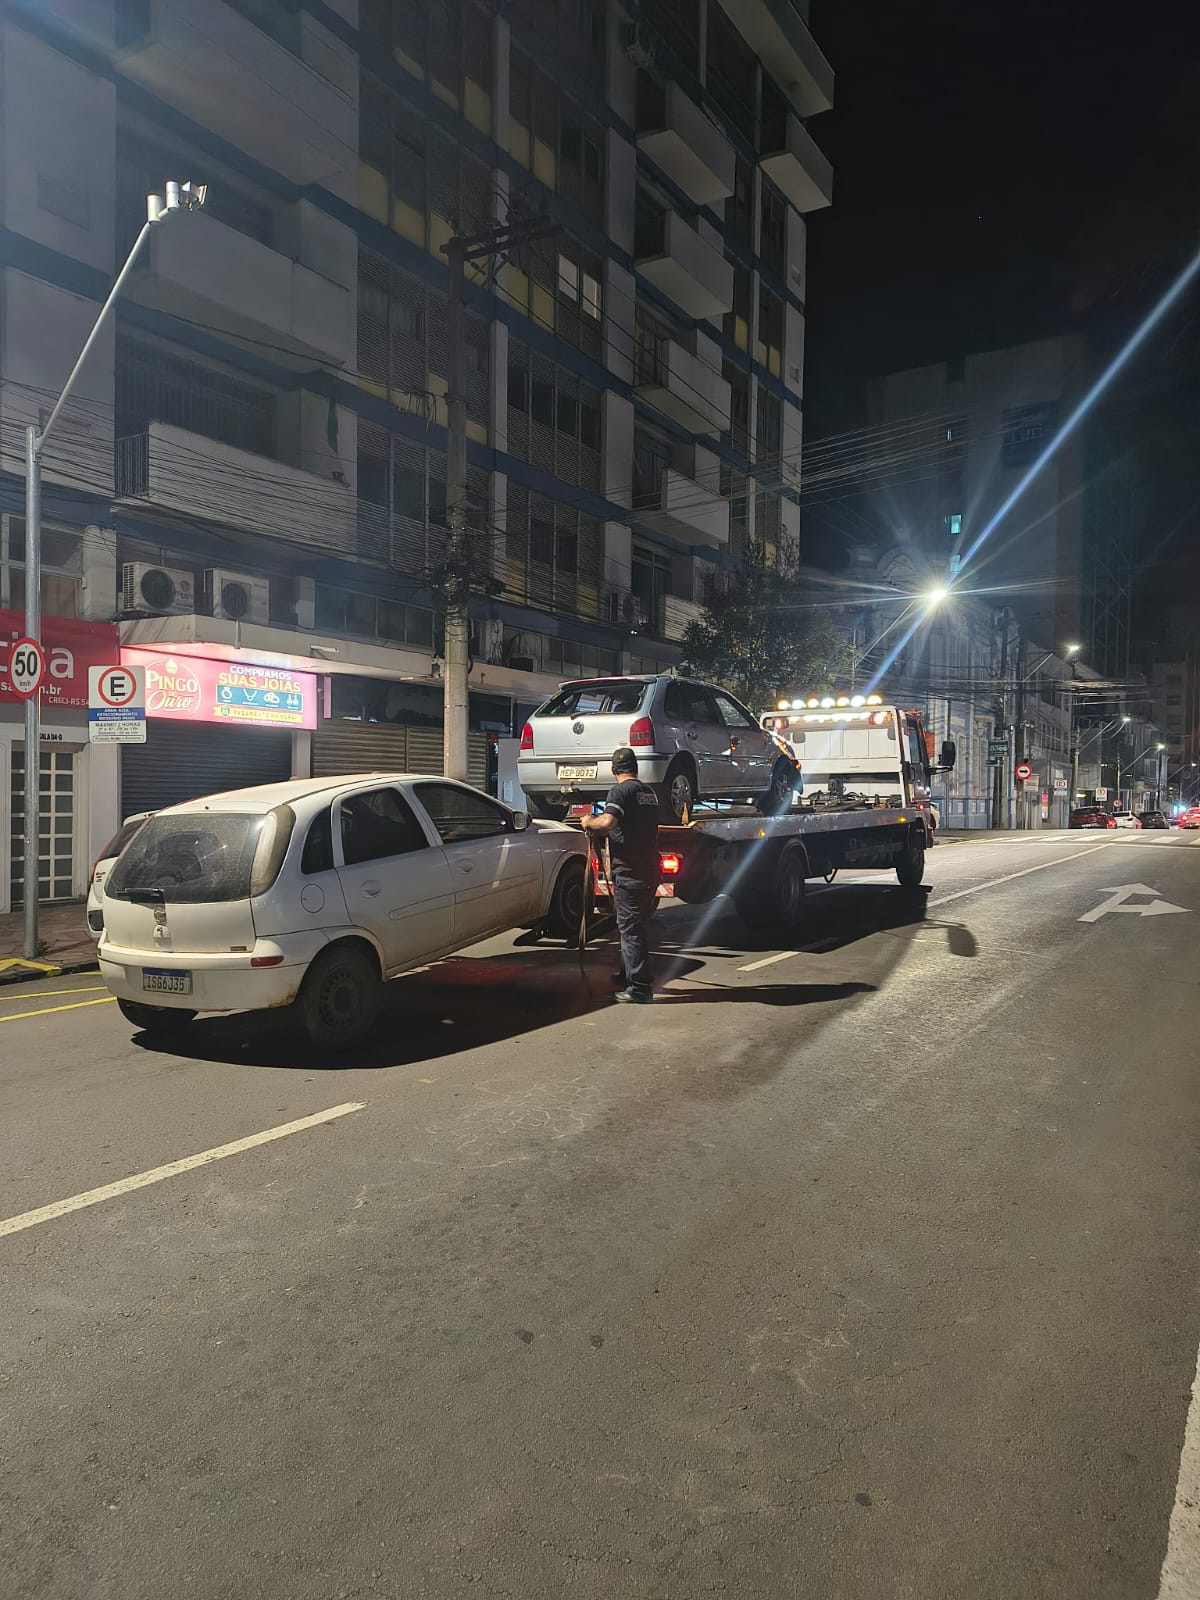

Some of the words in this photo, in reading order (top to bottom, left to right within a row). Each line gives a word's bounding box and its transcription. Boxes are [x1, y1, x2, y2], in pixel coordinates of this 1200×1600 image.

[14, 651, 38, 677] 50
[229, 666, 292, 681] COMPRAMOS
[110, 676, 126, 697] E
[145, 669, 198, 693] PINGO
[218, 673, 257, 688] SUAS
[261, 678, 301, 692] JOIAS
